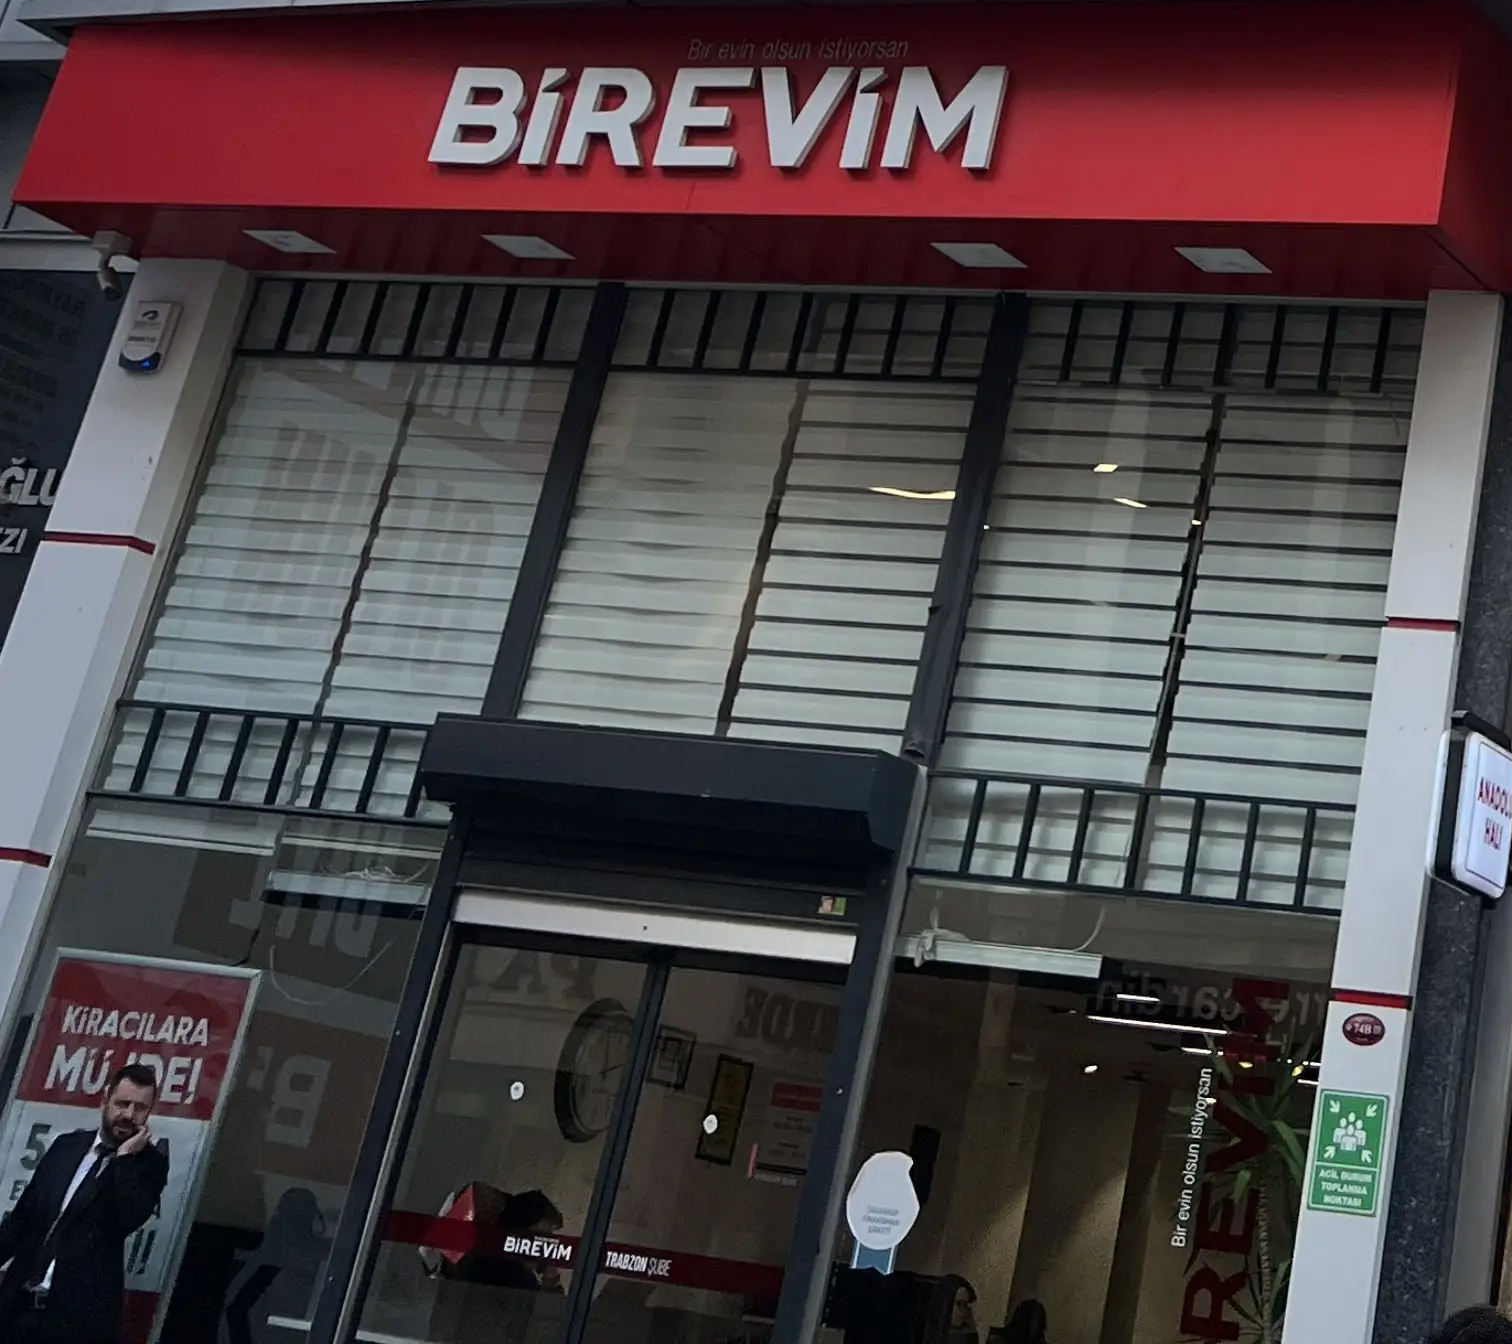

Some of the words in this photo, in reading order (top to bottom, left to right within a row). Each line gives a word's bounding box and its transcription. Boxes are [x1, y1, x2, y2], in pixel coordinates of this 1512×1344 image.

[718, 39, 755, 60] evin
[762, 37, 811, 60] olsun
[817, 35, 909, 63] istiyorsan
[427, 64, 1009, 172] BİREVİM
[61, 1004, 210, 1048] KİRACILARA
[1353, 1022, 1372, 1034] 74B
[1190, 1068, 1213, 1142] istiyorsan
[1181, 1148, 1199, 1187] olsun
[1176, 1190, 1191, 1223] evin
[503, 1235, 573, 1261] BİREVİM
[1171, 1225, 1186, 1248] Bir
[605, 1250, 648, 1274] TRABZON
[647, 1257, 673, 1278] ŞUBE
